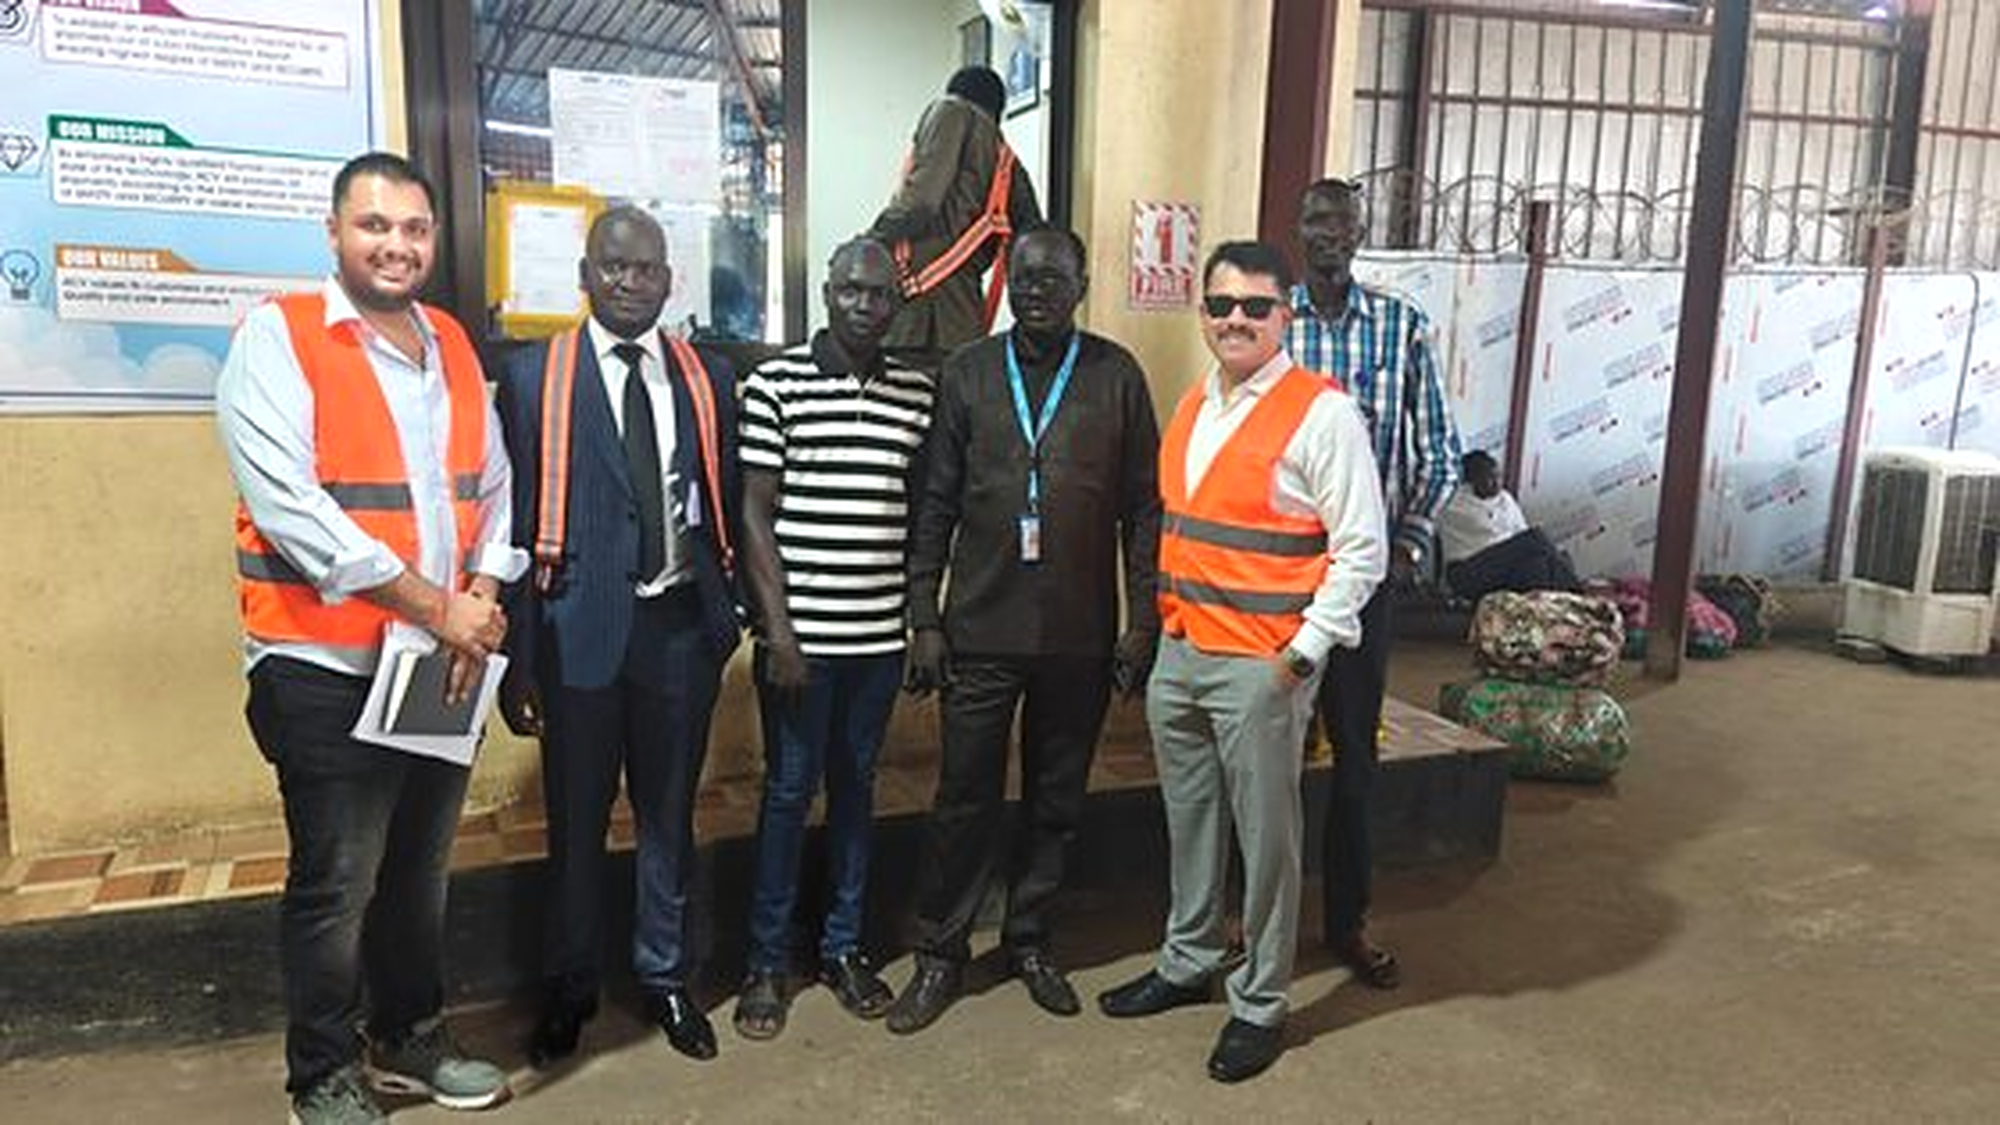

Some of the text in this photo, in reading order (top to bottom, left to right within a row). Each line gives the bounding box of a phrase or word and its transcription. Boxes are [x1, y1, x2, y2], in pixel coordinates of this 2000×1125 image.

[58, 121, 165, 143] OUR MISSION
[62, 249, 158, 268] OUR VALUES
